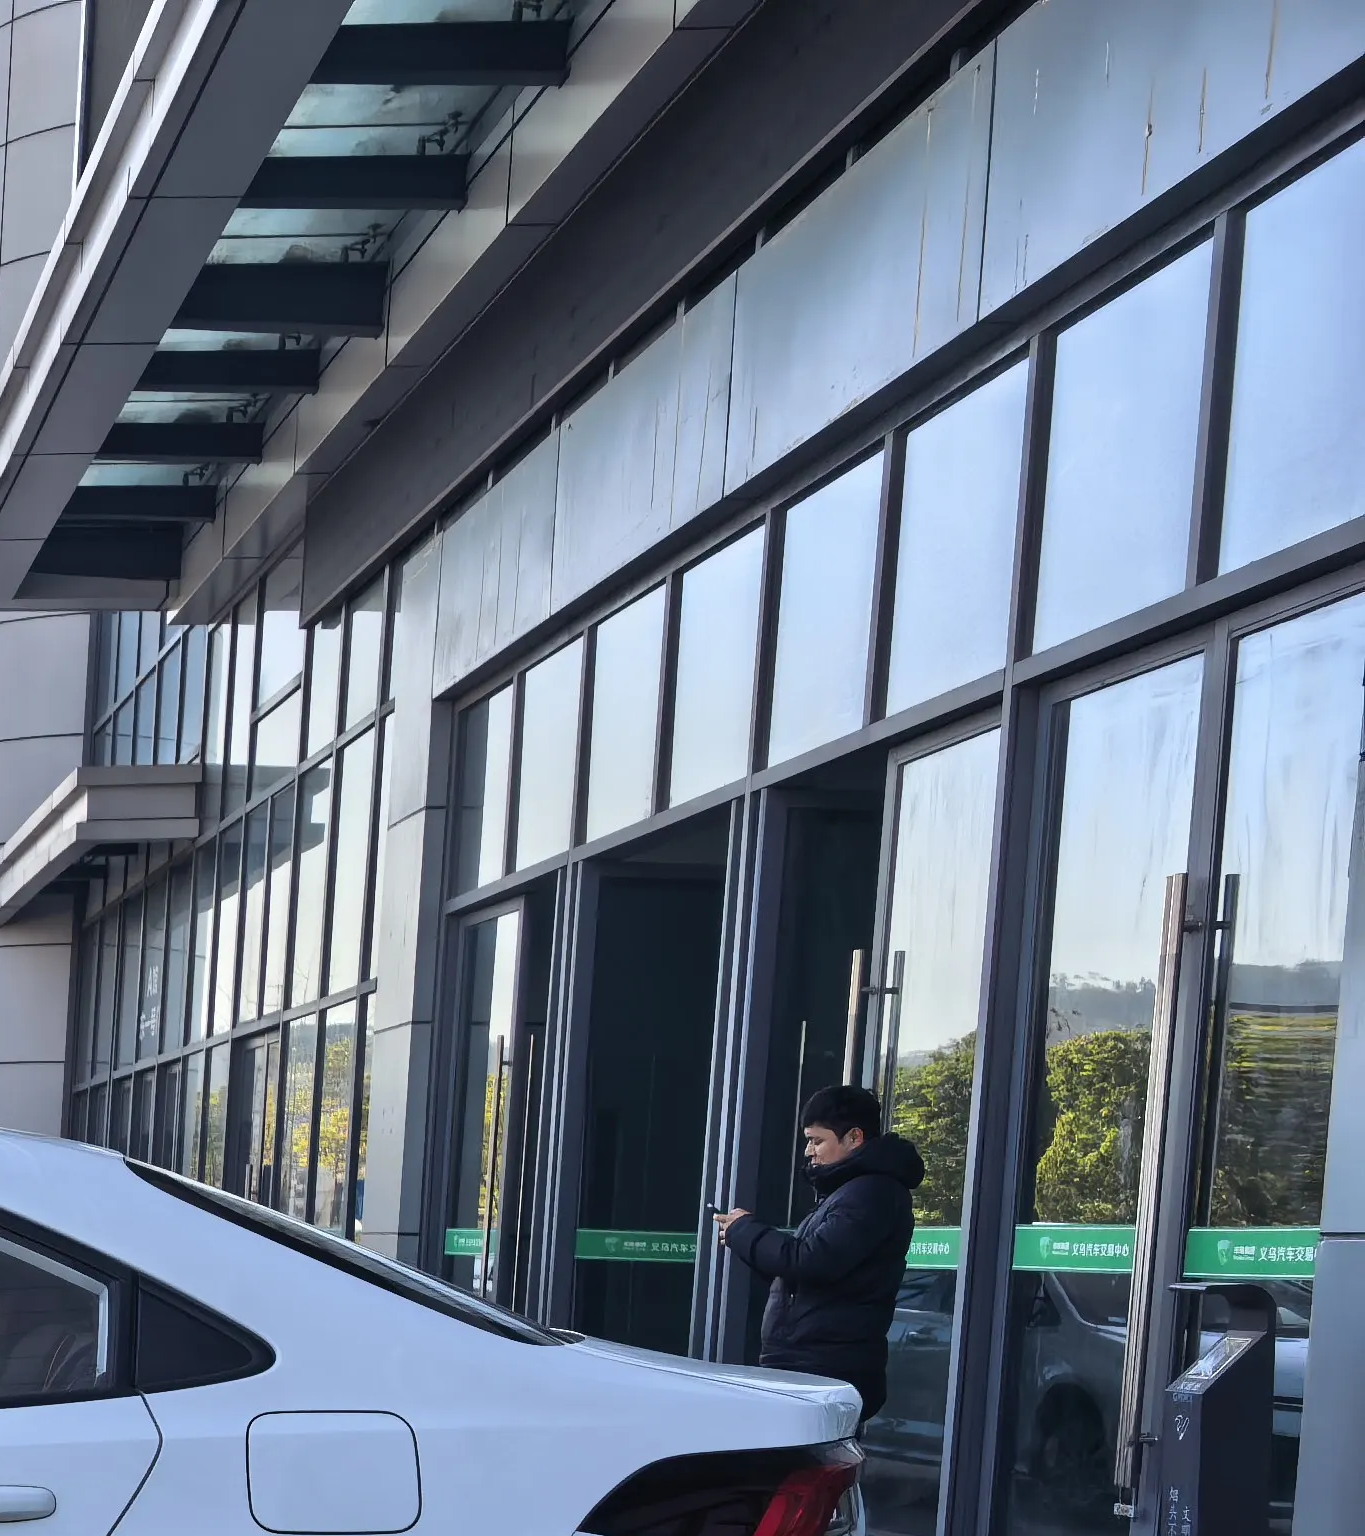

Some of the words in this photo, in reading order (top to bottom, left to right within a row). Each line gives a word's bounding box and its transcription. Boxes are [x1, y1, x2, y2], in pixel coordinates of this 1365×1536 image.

[1257, 1246, 1317, 1262] 义乌汽车交易
